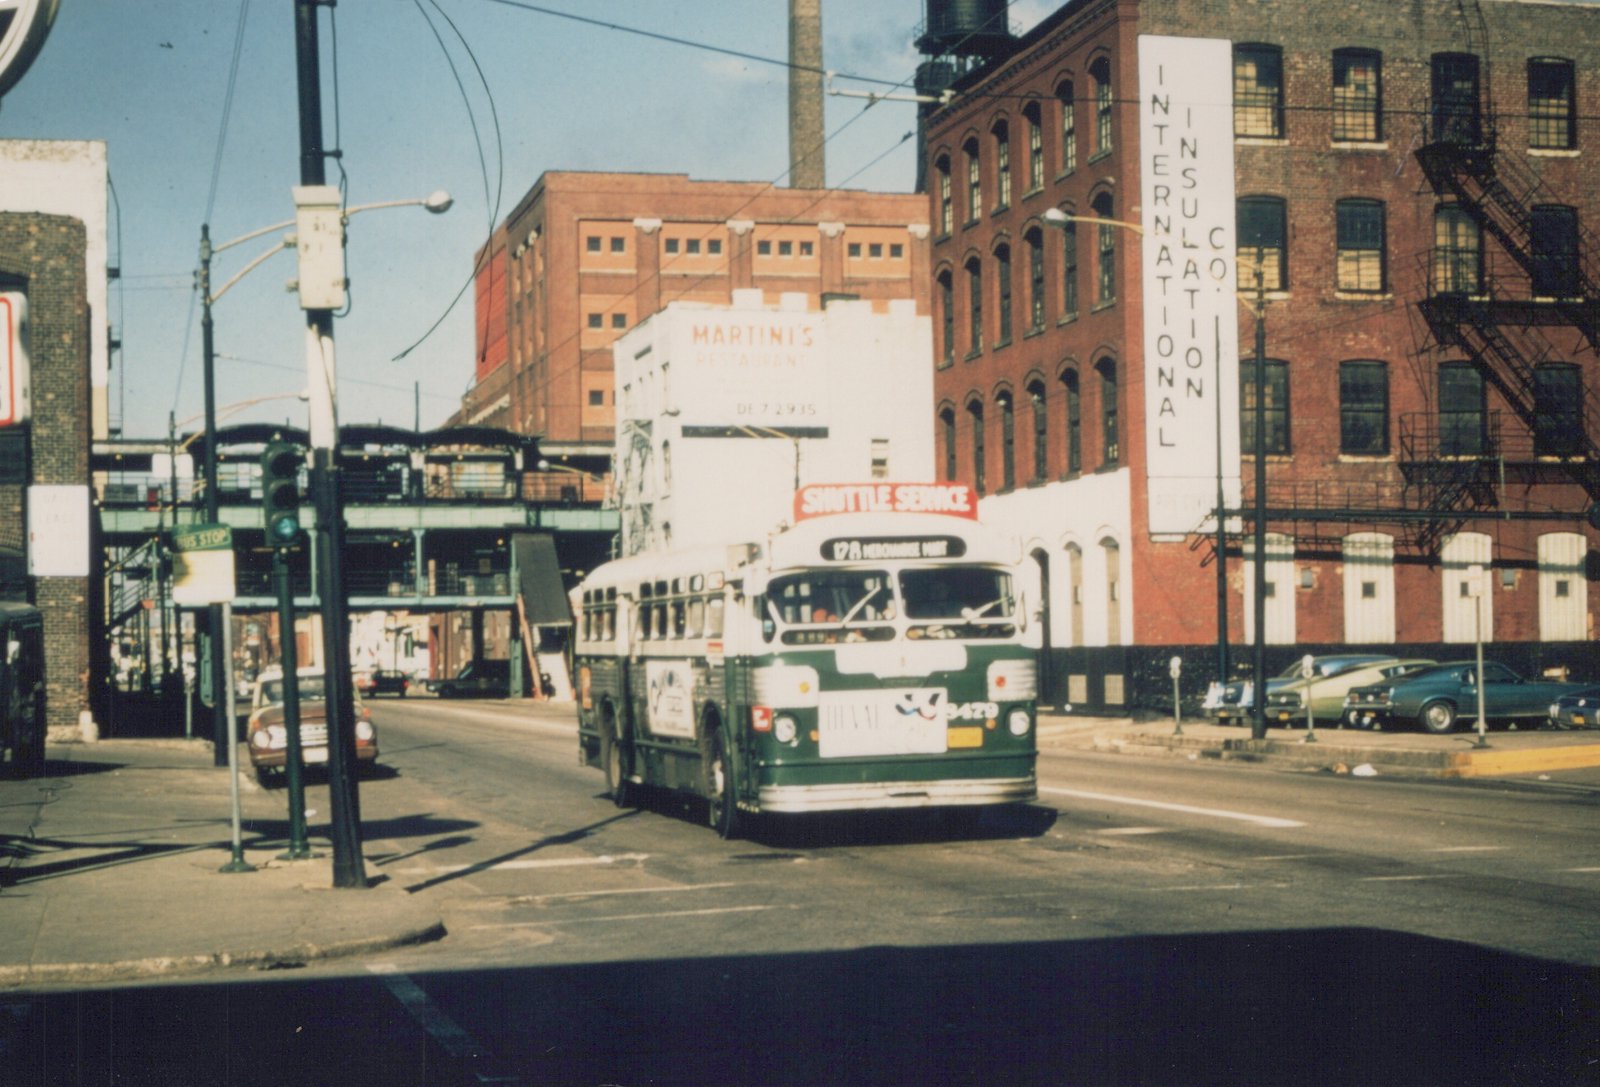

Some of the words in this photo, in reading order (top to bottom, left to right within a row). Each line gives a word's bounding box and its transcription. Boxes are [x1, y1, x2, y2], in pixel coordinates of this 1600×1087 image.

[1151, 64, 1176, 447] INTERNATIONAL
[1180, 107, 1203, 398] INSULATION
[1208, 226, 1227, 293] CO.
[802, 486, 892, 513] SHUTTLE
[896, 485, 970, 512] SERVICE
[199, 528, 226, 547] STOP
